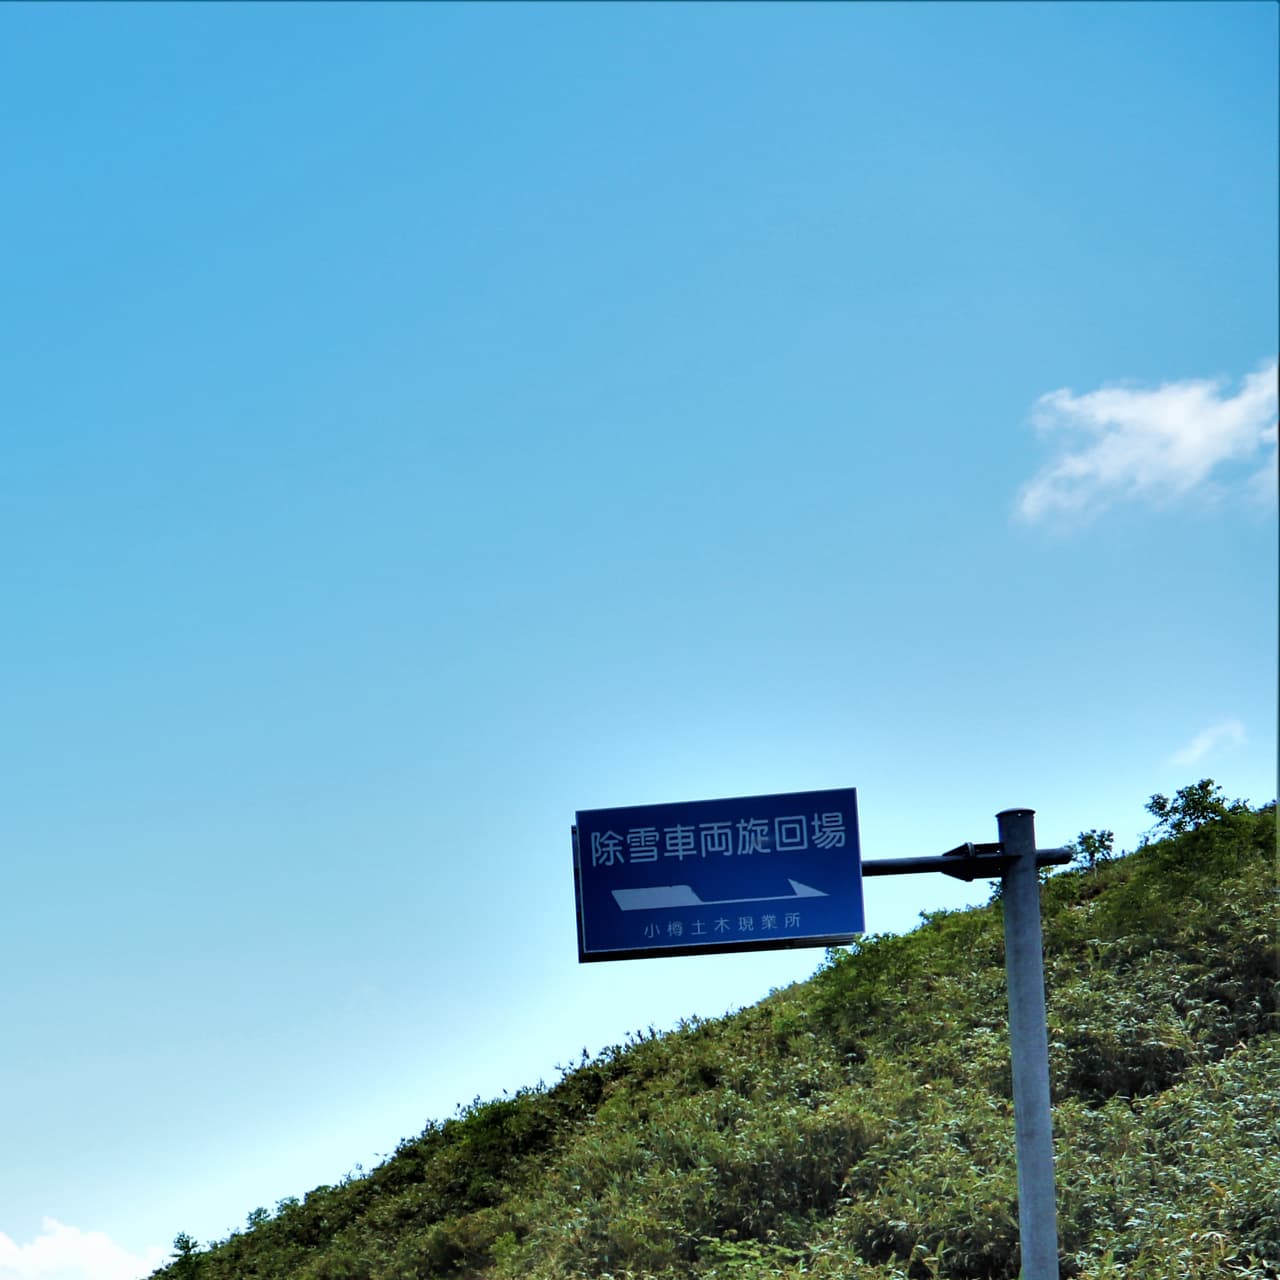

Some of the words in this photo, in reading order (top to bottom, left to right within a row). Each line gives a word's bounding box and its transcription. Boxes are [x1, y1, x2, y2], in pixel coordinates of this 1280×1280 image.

[590, 812, 846, 867] 除雪車両旋回場
[643, 912, 801, 939] 小樽土木現業所
